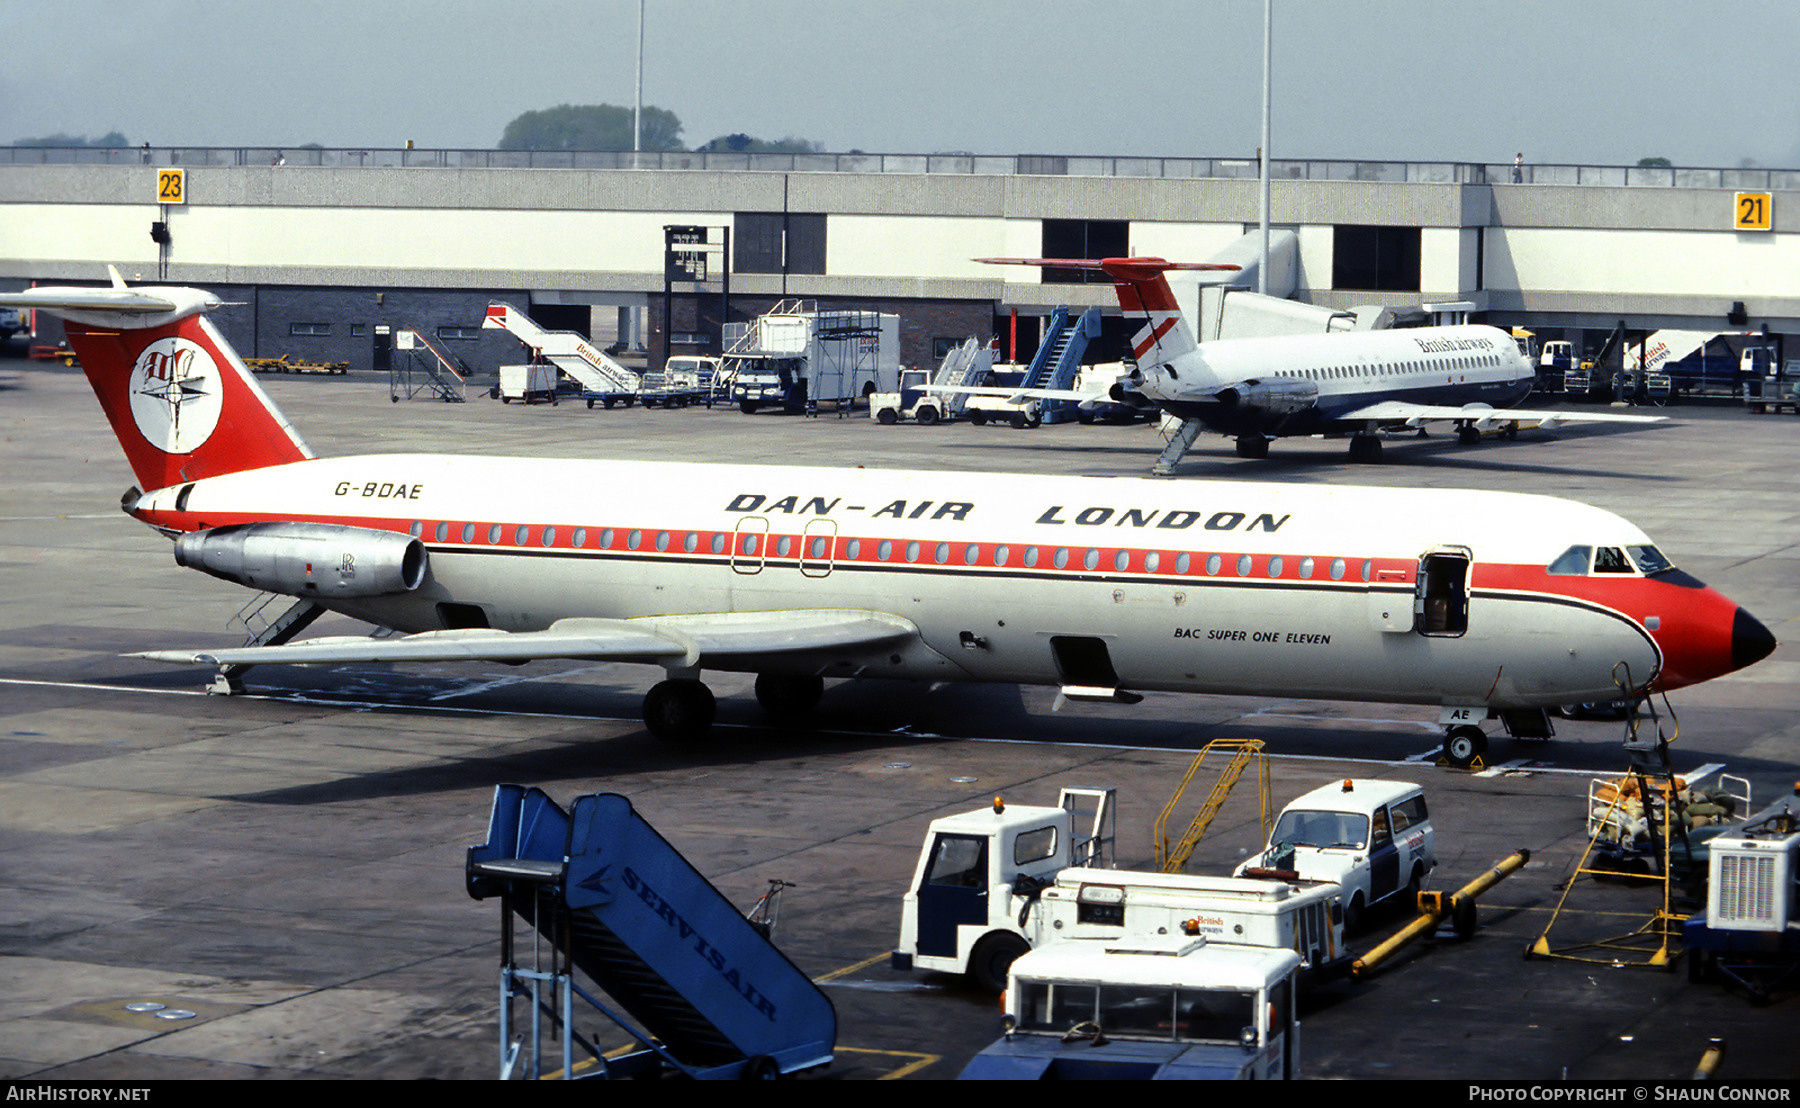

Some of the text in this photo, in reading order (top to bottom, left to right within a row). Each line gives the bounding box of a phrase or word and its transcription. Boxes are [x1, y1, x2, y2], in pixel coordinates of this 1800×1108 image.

[160, 173, 182, 198] 23
[1740, 197, 1763, 224] 21
[576, 343, 602, 367] British
[1413, 336, 1495, 354] British airways
[1637, 342, 1667, 362] ritish
[334, 481, 424, 500] G-BDAE
[723, 493, 1292, 533] DAN-AIR LONDON
[1173, 627, 1331, 645] BAC SUPER ONE ELEVEN
[1450, 709, 1470, 720] AE
[1197, 915, 1224, 926] British
[621, 866, 777, 1022] SERVISAIR
